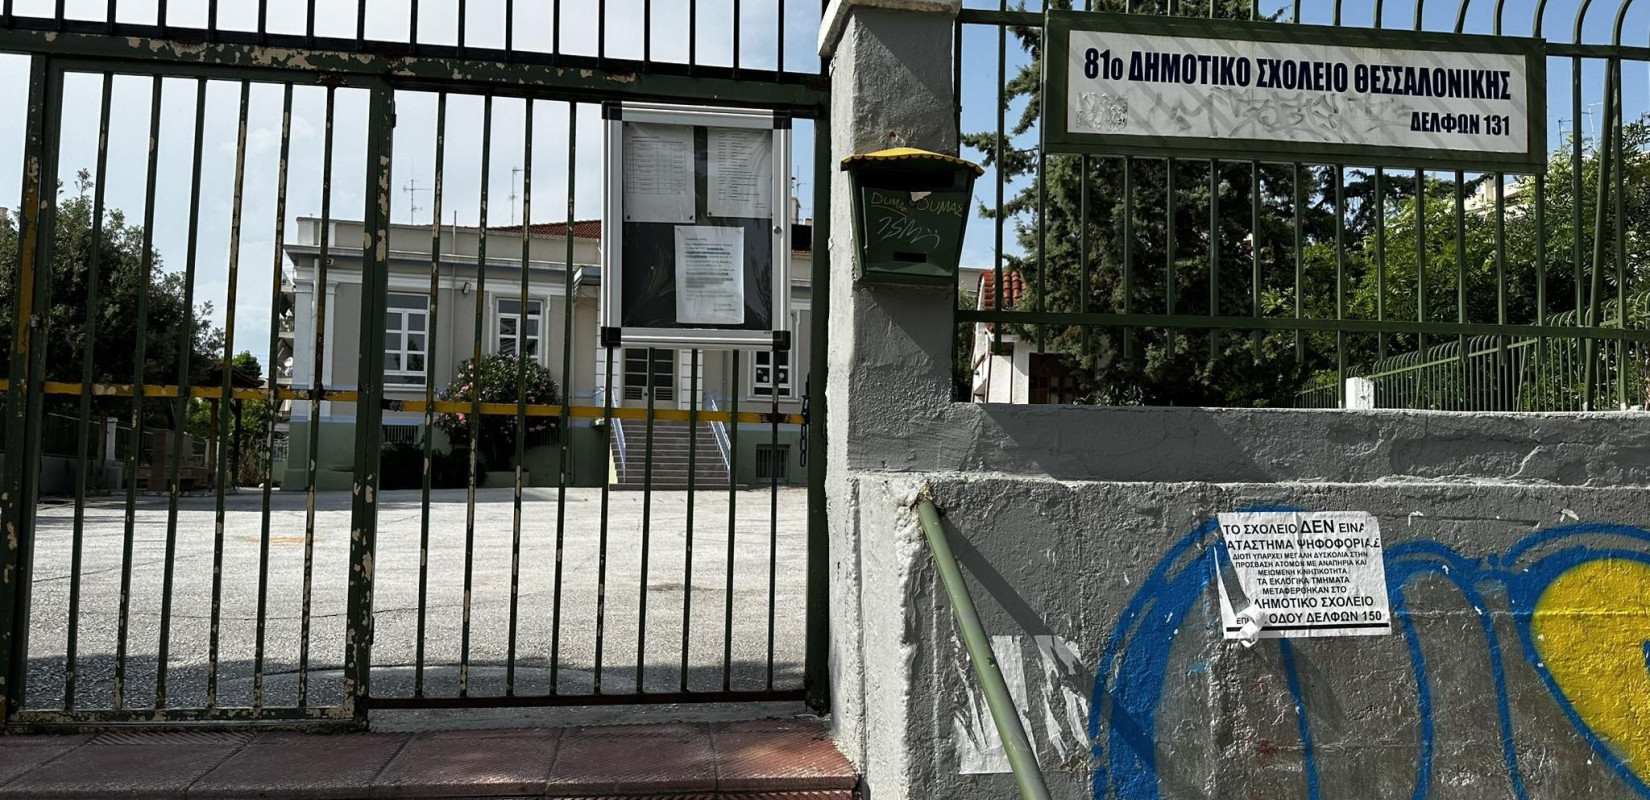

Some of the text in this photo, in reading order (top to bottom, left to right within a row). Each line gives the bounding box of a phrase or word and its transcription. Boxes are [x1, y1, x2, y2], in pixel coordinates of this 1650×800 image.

[1128, 51, 1250, 87] ΔΗΜΟΤΙΚΟ
[1256, 57, 1348, 93] ΣΧΟΛΕΙΟ
[1354, 63, 1511, 100] ΘΕΣΣΑΛΟΝΙΚΗΣ
[1410, 111, 1510, 136] ΔΕΛΦΩΝ 131
[1223, 519, 1365, 535] ΤΟ ΣΧΟΛΕΙΟ ΔΕΝ ΕΙΝΑ
[1227, 539, 1294, 551] ΑΤΑΣΤΗΜΑ
[1252, 552, 1283, 560] ΥΠΑΡΧΕΙ
[1314, 551, 1349, 559] ΔΥΣΚΟΛΙΑ
[1318, 559, 1354, 567] ΑΝΑΠΗΡΙΑ
[1257, 576, 1351, 586] ΤΑ ΕΚΛΟΓΙΚΑ ΤΜΗΜΑΤΑ
[1262, 586, 1347, 595] ΜΕΤΑΦΕΡΘΗΚΑΝ ΣΤΟ
[1321, 595, 1374, 608] ΣΧΟΛΕΙΟ
[1268, 612, 1303, 624] ΟΔΟΥ
[1306, 611, 1361, 623] ΔΕΛΦΩΝ
[1362, 610, 1382, 622] 150
